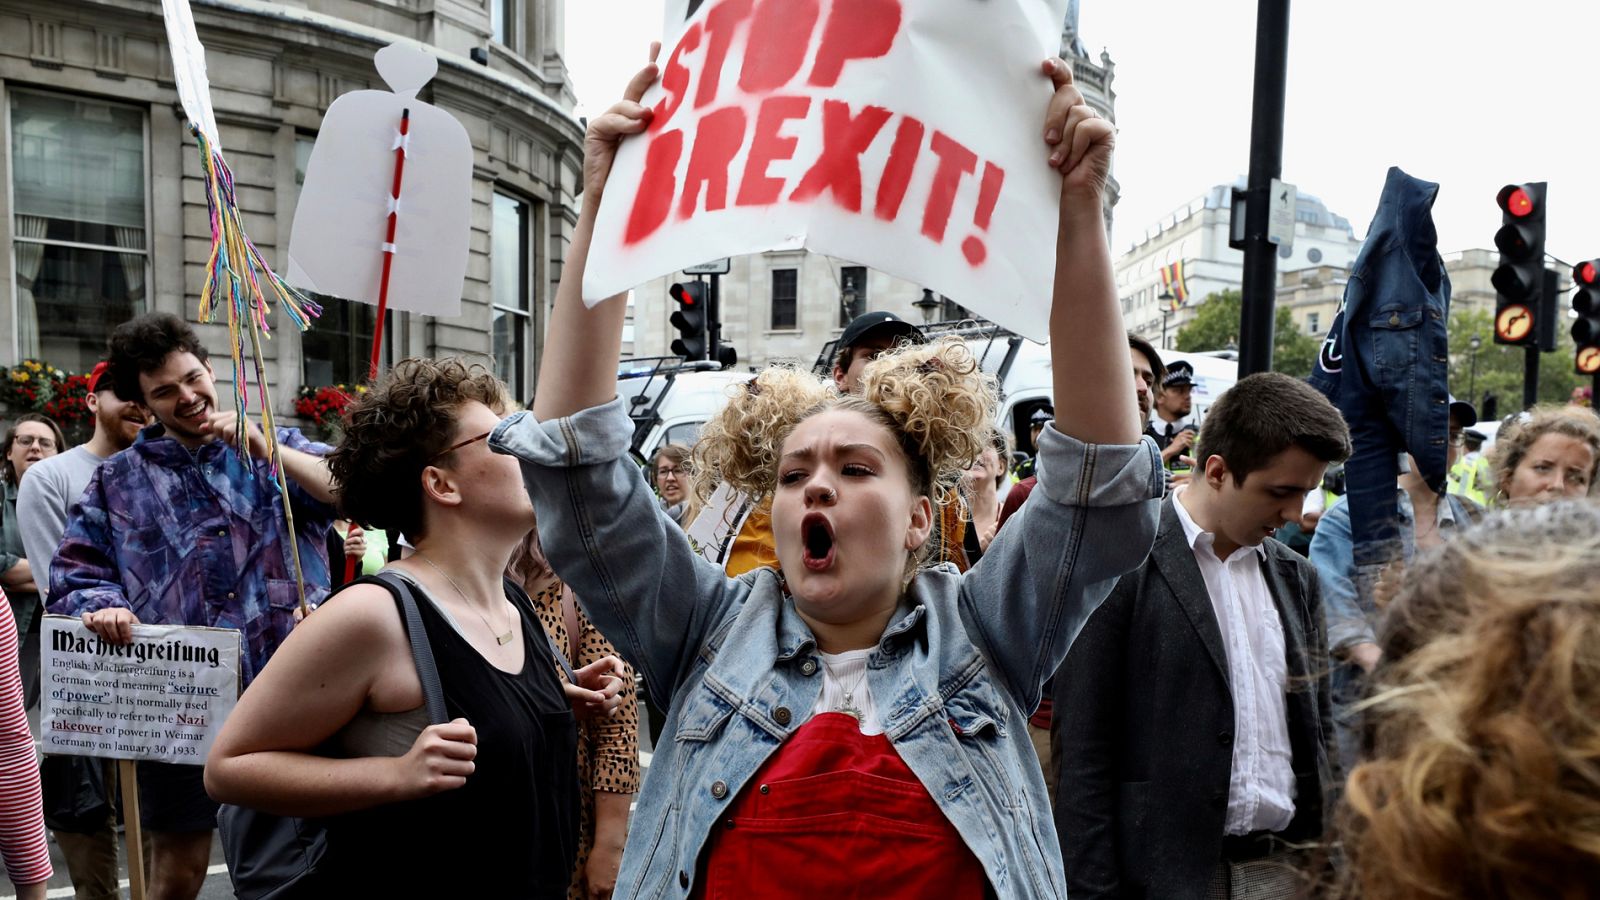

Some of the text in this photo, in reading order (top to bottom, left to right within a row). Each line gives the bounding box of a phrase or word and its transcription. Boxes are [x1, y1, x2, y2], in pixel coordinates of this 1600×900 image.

[648, 0, 902, 133] STOP
[622, 96, 1006, 268] BREXIT!
[52, 629, 219, 668] Machtergreifung
[52, 657, 195, 680] English: Machtergreifung is a
[51, 673, 91, 686] German
[94, 679, 119, 689] word
[121, 682, 166, 695] meaning
[52, 688, 65, 699] of
[116, 695, 123, 705] It
[126, 696, 134, 705] is
[136, 698, 182, 711] normally
[184, 700, 208, 710] used
[51, 706, 205, 726] specifically to refer to the Nazi
[51, 720, 204, 741] takeover of power in Weimar
[51, 736, 97, 750] Germany
[114, 741, 152, 755] January
[173, 746, 199, 756] 1933.
